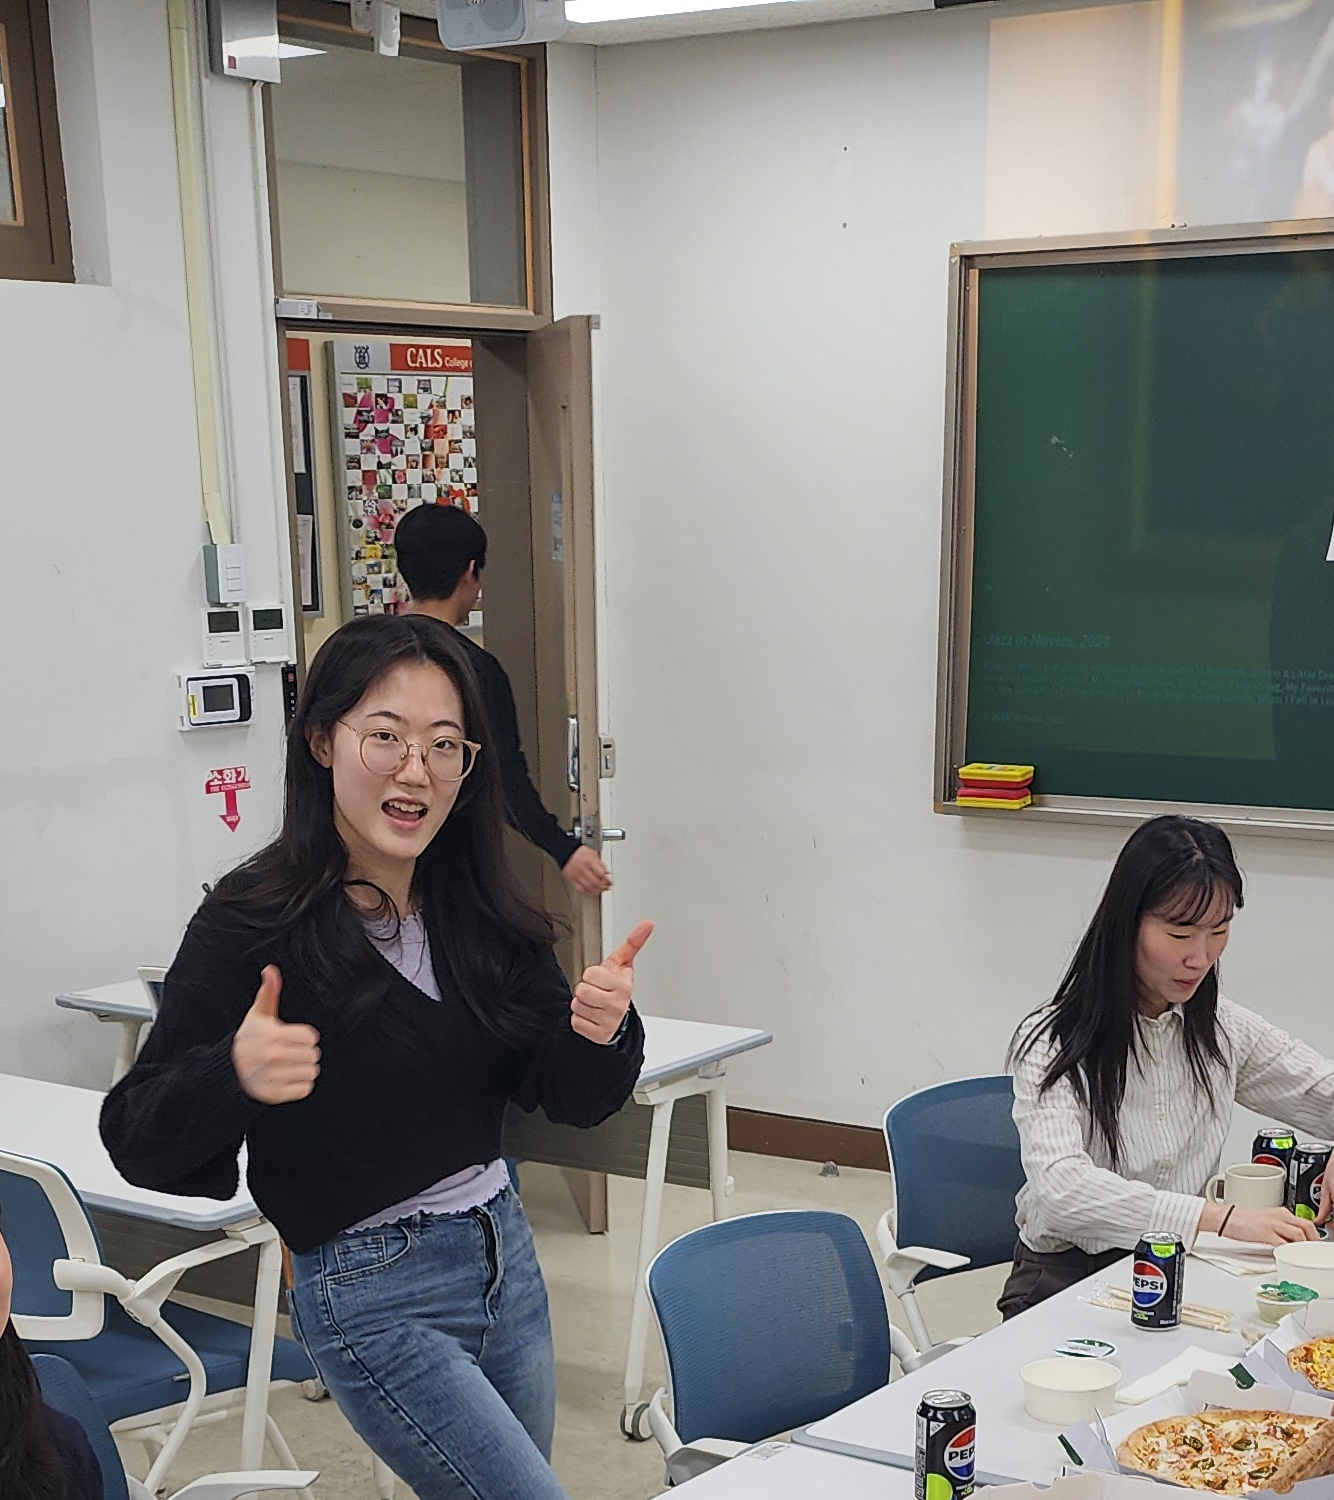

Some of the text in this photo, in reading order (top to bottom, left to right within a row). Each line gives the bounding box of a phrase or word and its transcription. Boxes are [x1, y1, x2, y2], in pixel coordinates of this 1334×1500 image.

[406, 347, 443, 368] CALS
[208, 767, 250, 786] 소화기
[948, 1447, 975, 1461] PEP
